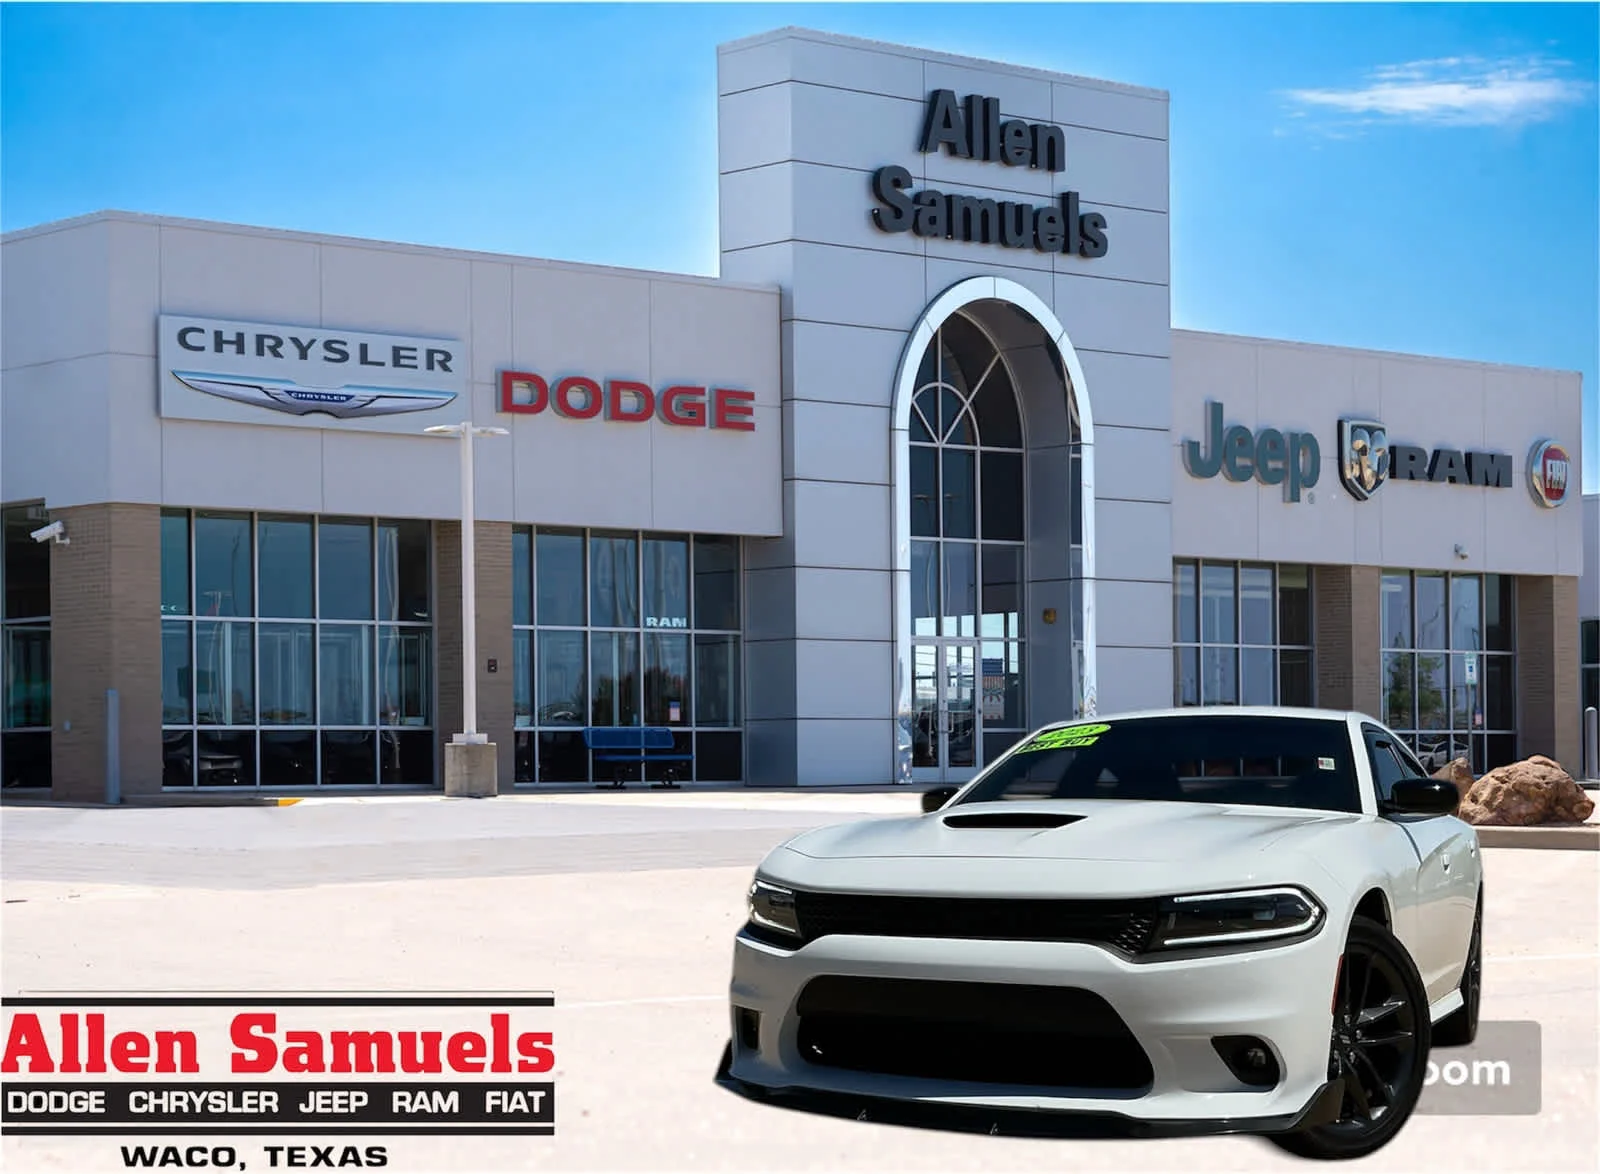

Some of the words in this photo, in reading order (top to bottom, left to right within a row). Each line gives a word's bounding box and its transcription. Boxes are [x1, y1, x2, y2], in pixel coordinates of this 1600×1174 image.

[919, 89, 1066, 172] Allen
[871, 165, 1108, 258] Samuels
[177, 326, 454, 373] CHRYSLER
[291, 392, 347, 401] CHRYSLER
[496, 370, 755, 432] DODGE
[1182, 400, 1321, 503] Jeep
[1389, 445, 1512, 488] RAM
[1545, 459, 1568, 489] FIAT
[645, 616, 687, 628] RAM
